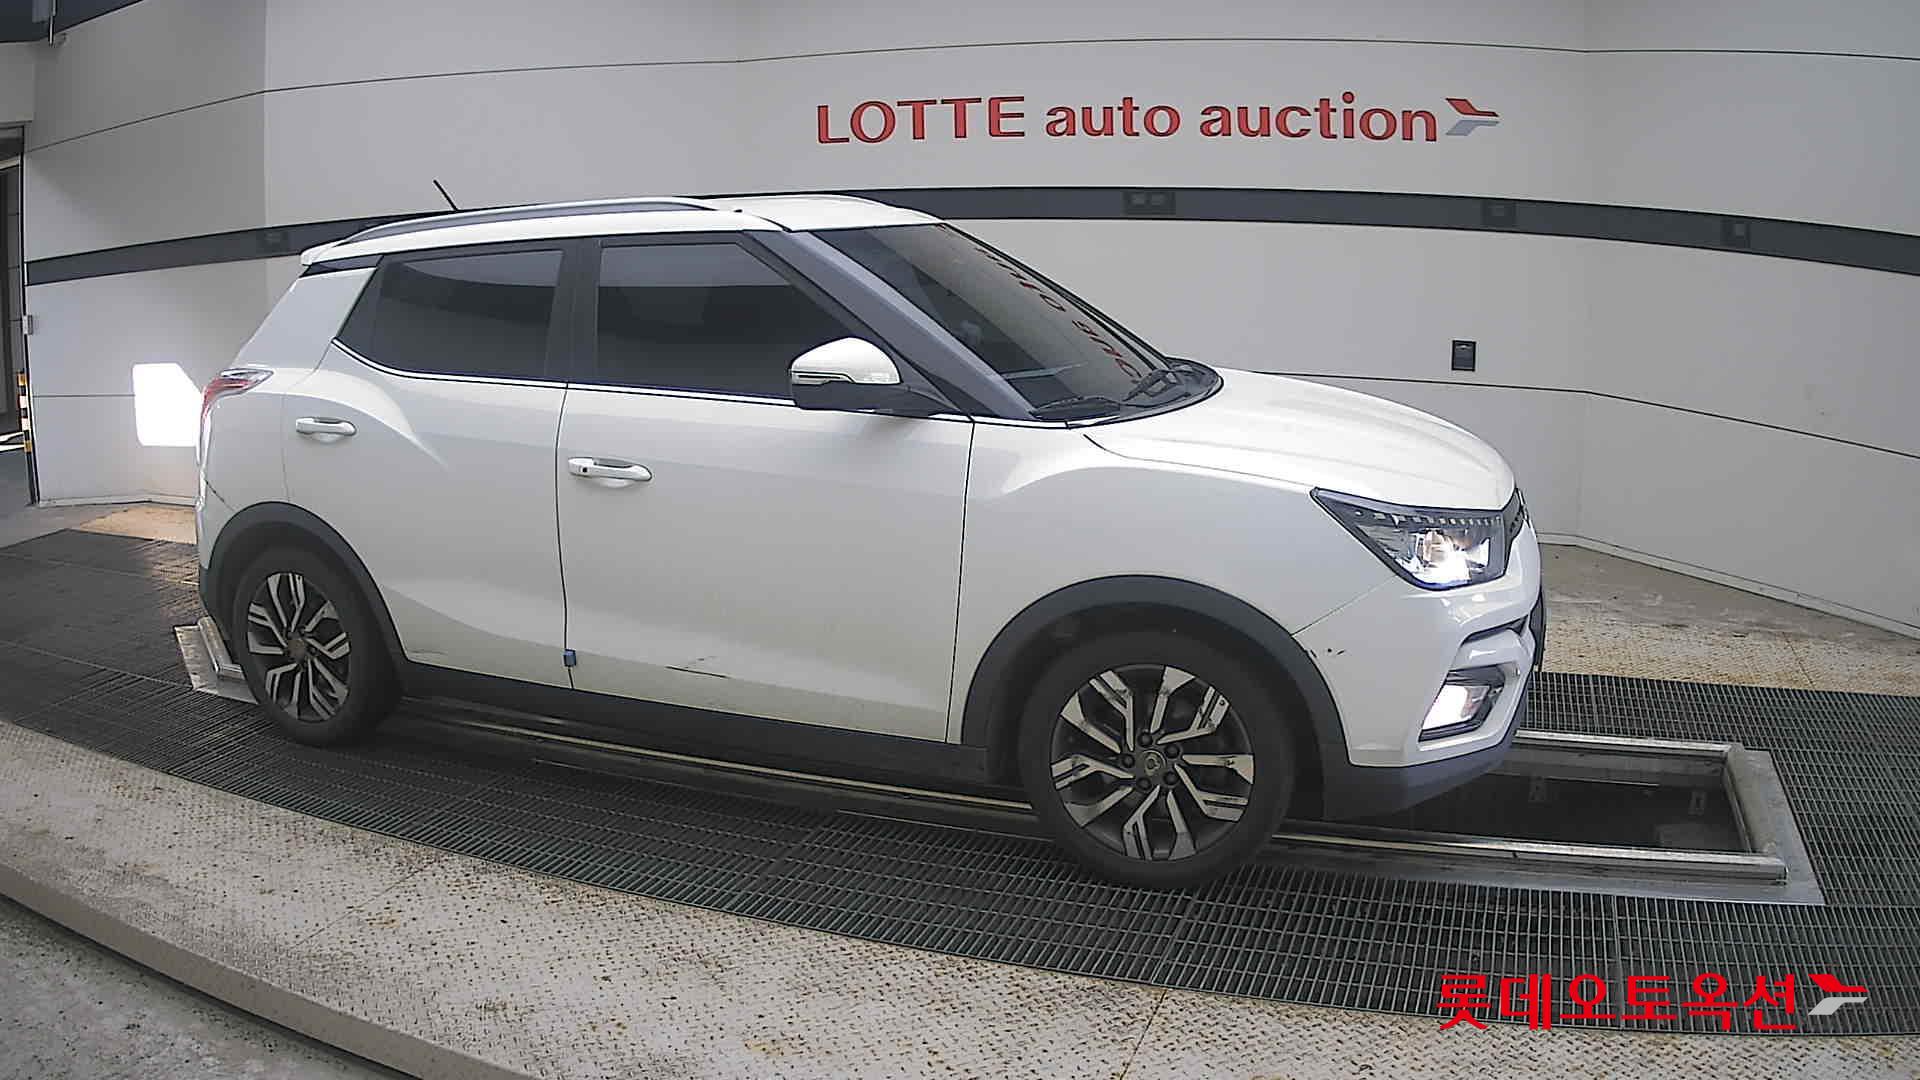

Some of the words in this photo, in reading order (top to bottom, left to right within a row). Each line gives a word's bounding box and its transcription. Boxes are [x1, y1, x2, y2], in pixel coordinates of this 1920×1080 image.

[817, 96, 1025, 144] LOTTE
[1045, 96, 1181, 138] auto
[1199, 91, 1438, 142] auction
